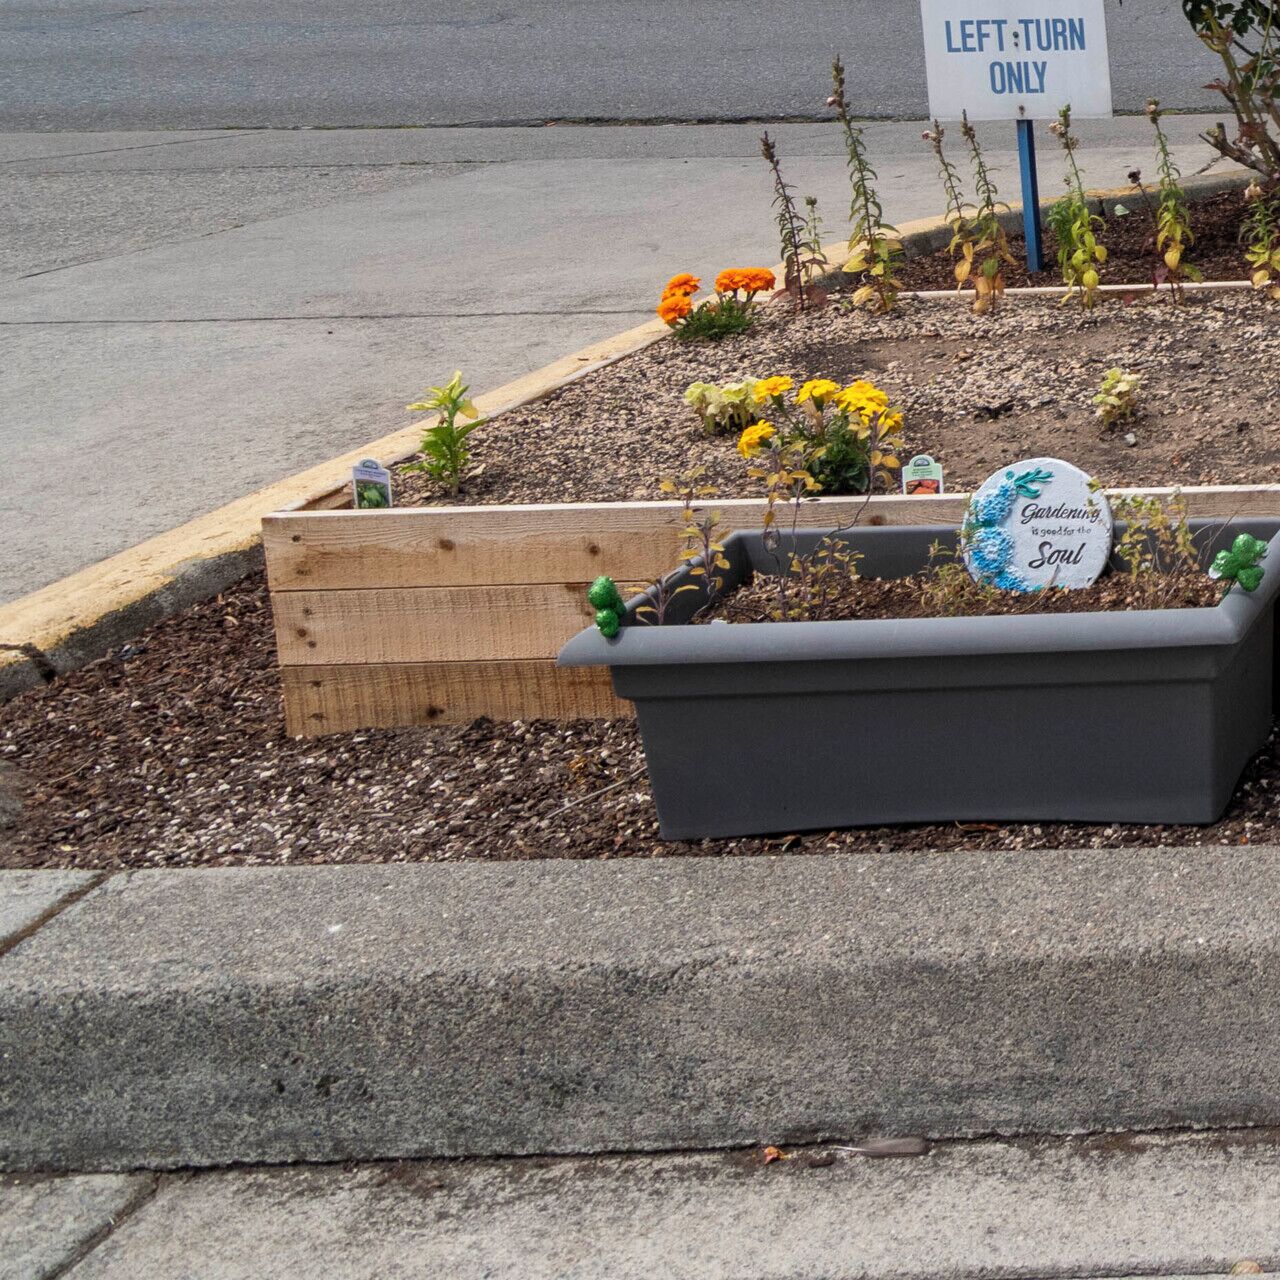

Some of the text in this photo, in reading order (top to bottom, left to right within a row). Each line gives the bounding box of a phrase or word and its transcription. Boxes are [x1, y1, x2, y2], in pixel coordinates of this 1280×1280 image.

[945, 18, 1086, 53] LEFT TURN
[989, 61, 1048, 95] ONLY
[1021, 503, 1101, 524] Gardening
[1032, 527, 1039, 535] is
[1040, 526, 1062, 538] good
[1062, 527, 1075, 536] for
[1028, 540, 1086, 569] Soul
